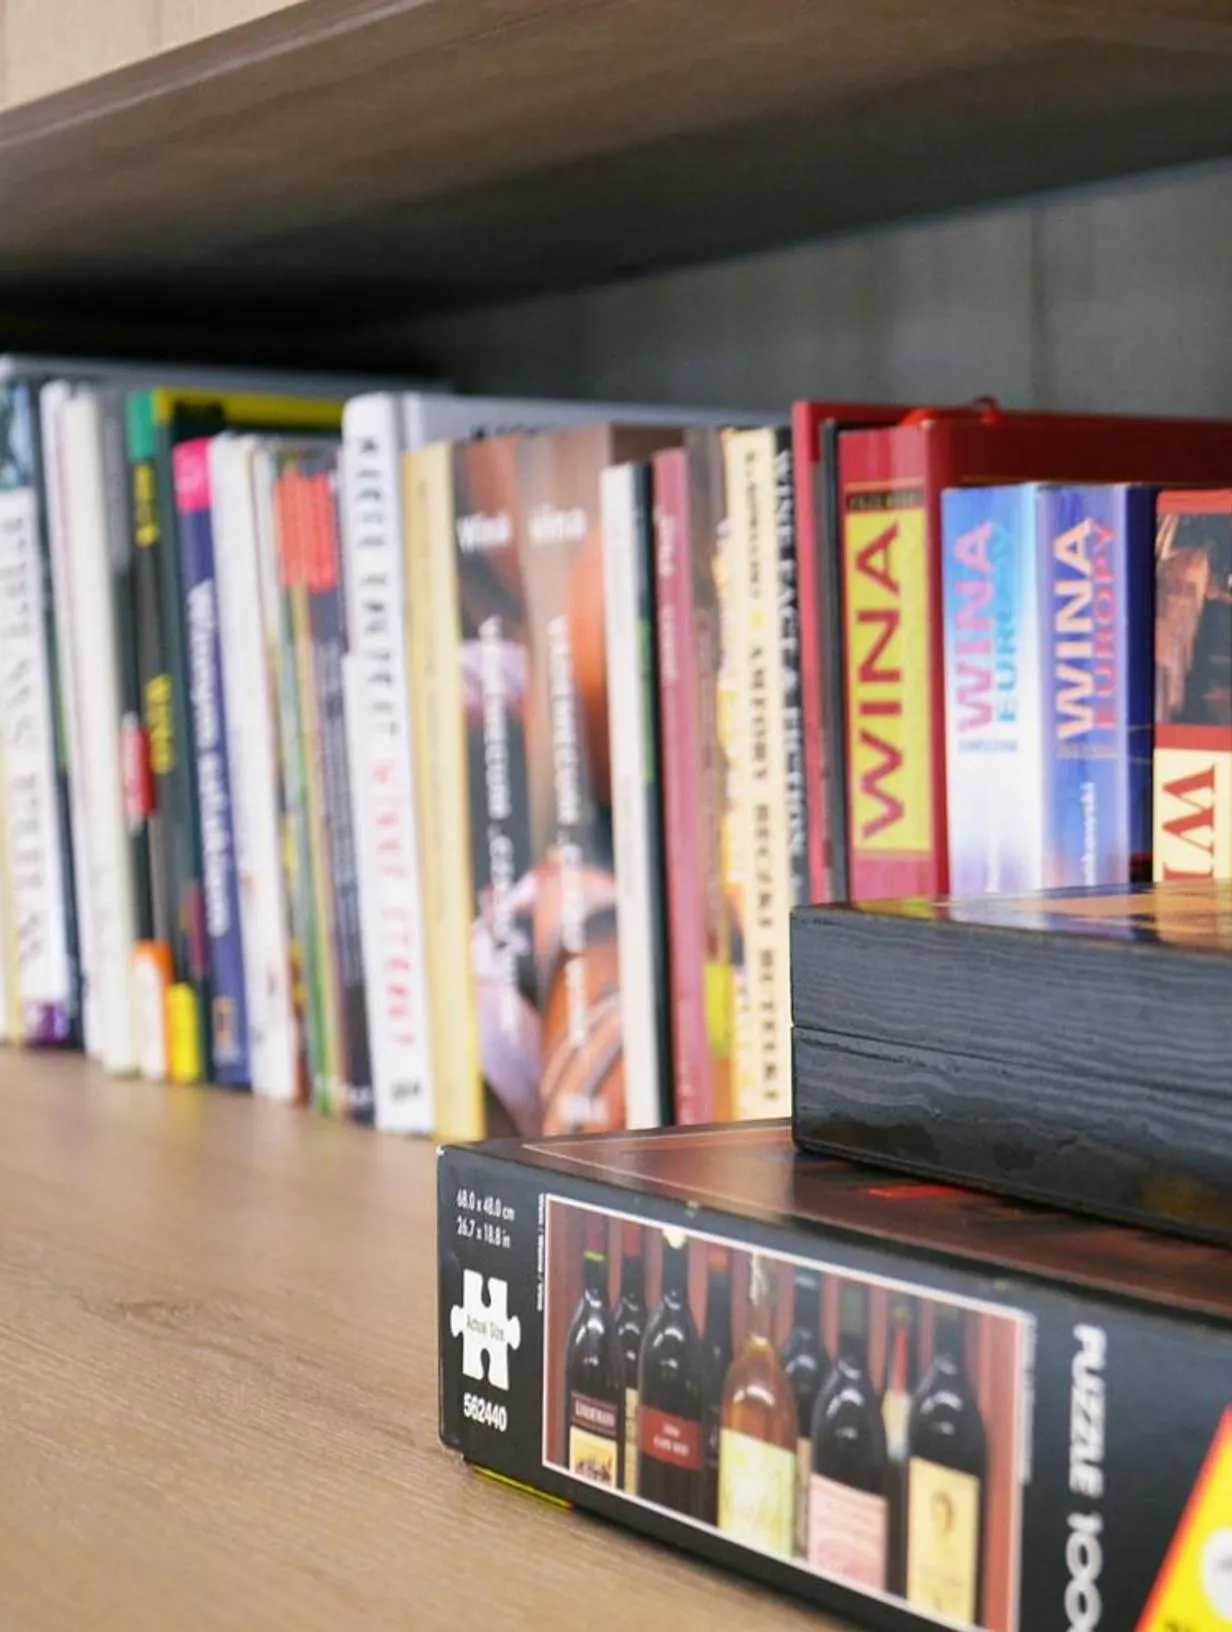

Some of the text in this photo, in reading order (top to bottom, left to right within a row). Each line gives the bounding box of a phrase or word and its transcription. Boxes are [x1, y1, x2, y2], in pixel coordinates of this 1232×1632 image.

[856, 523, 904, 839] WINA
[952, 519, 993, 733] WINA
[1052, 517, 1094, 740] WINA
[1160, 763, 1216, 881] W
[502, 1206, 516, 1222] cm
[502, 1228, 512, 1249] in
[463, 1391, 508, 1433] 562440
[1064, 1323, 1107, 1632] PUZZLE 100
